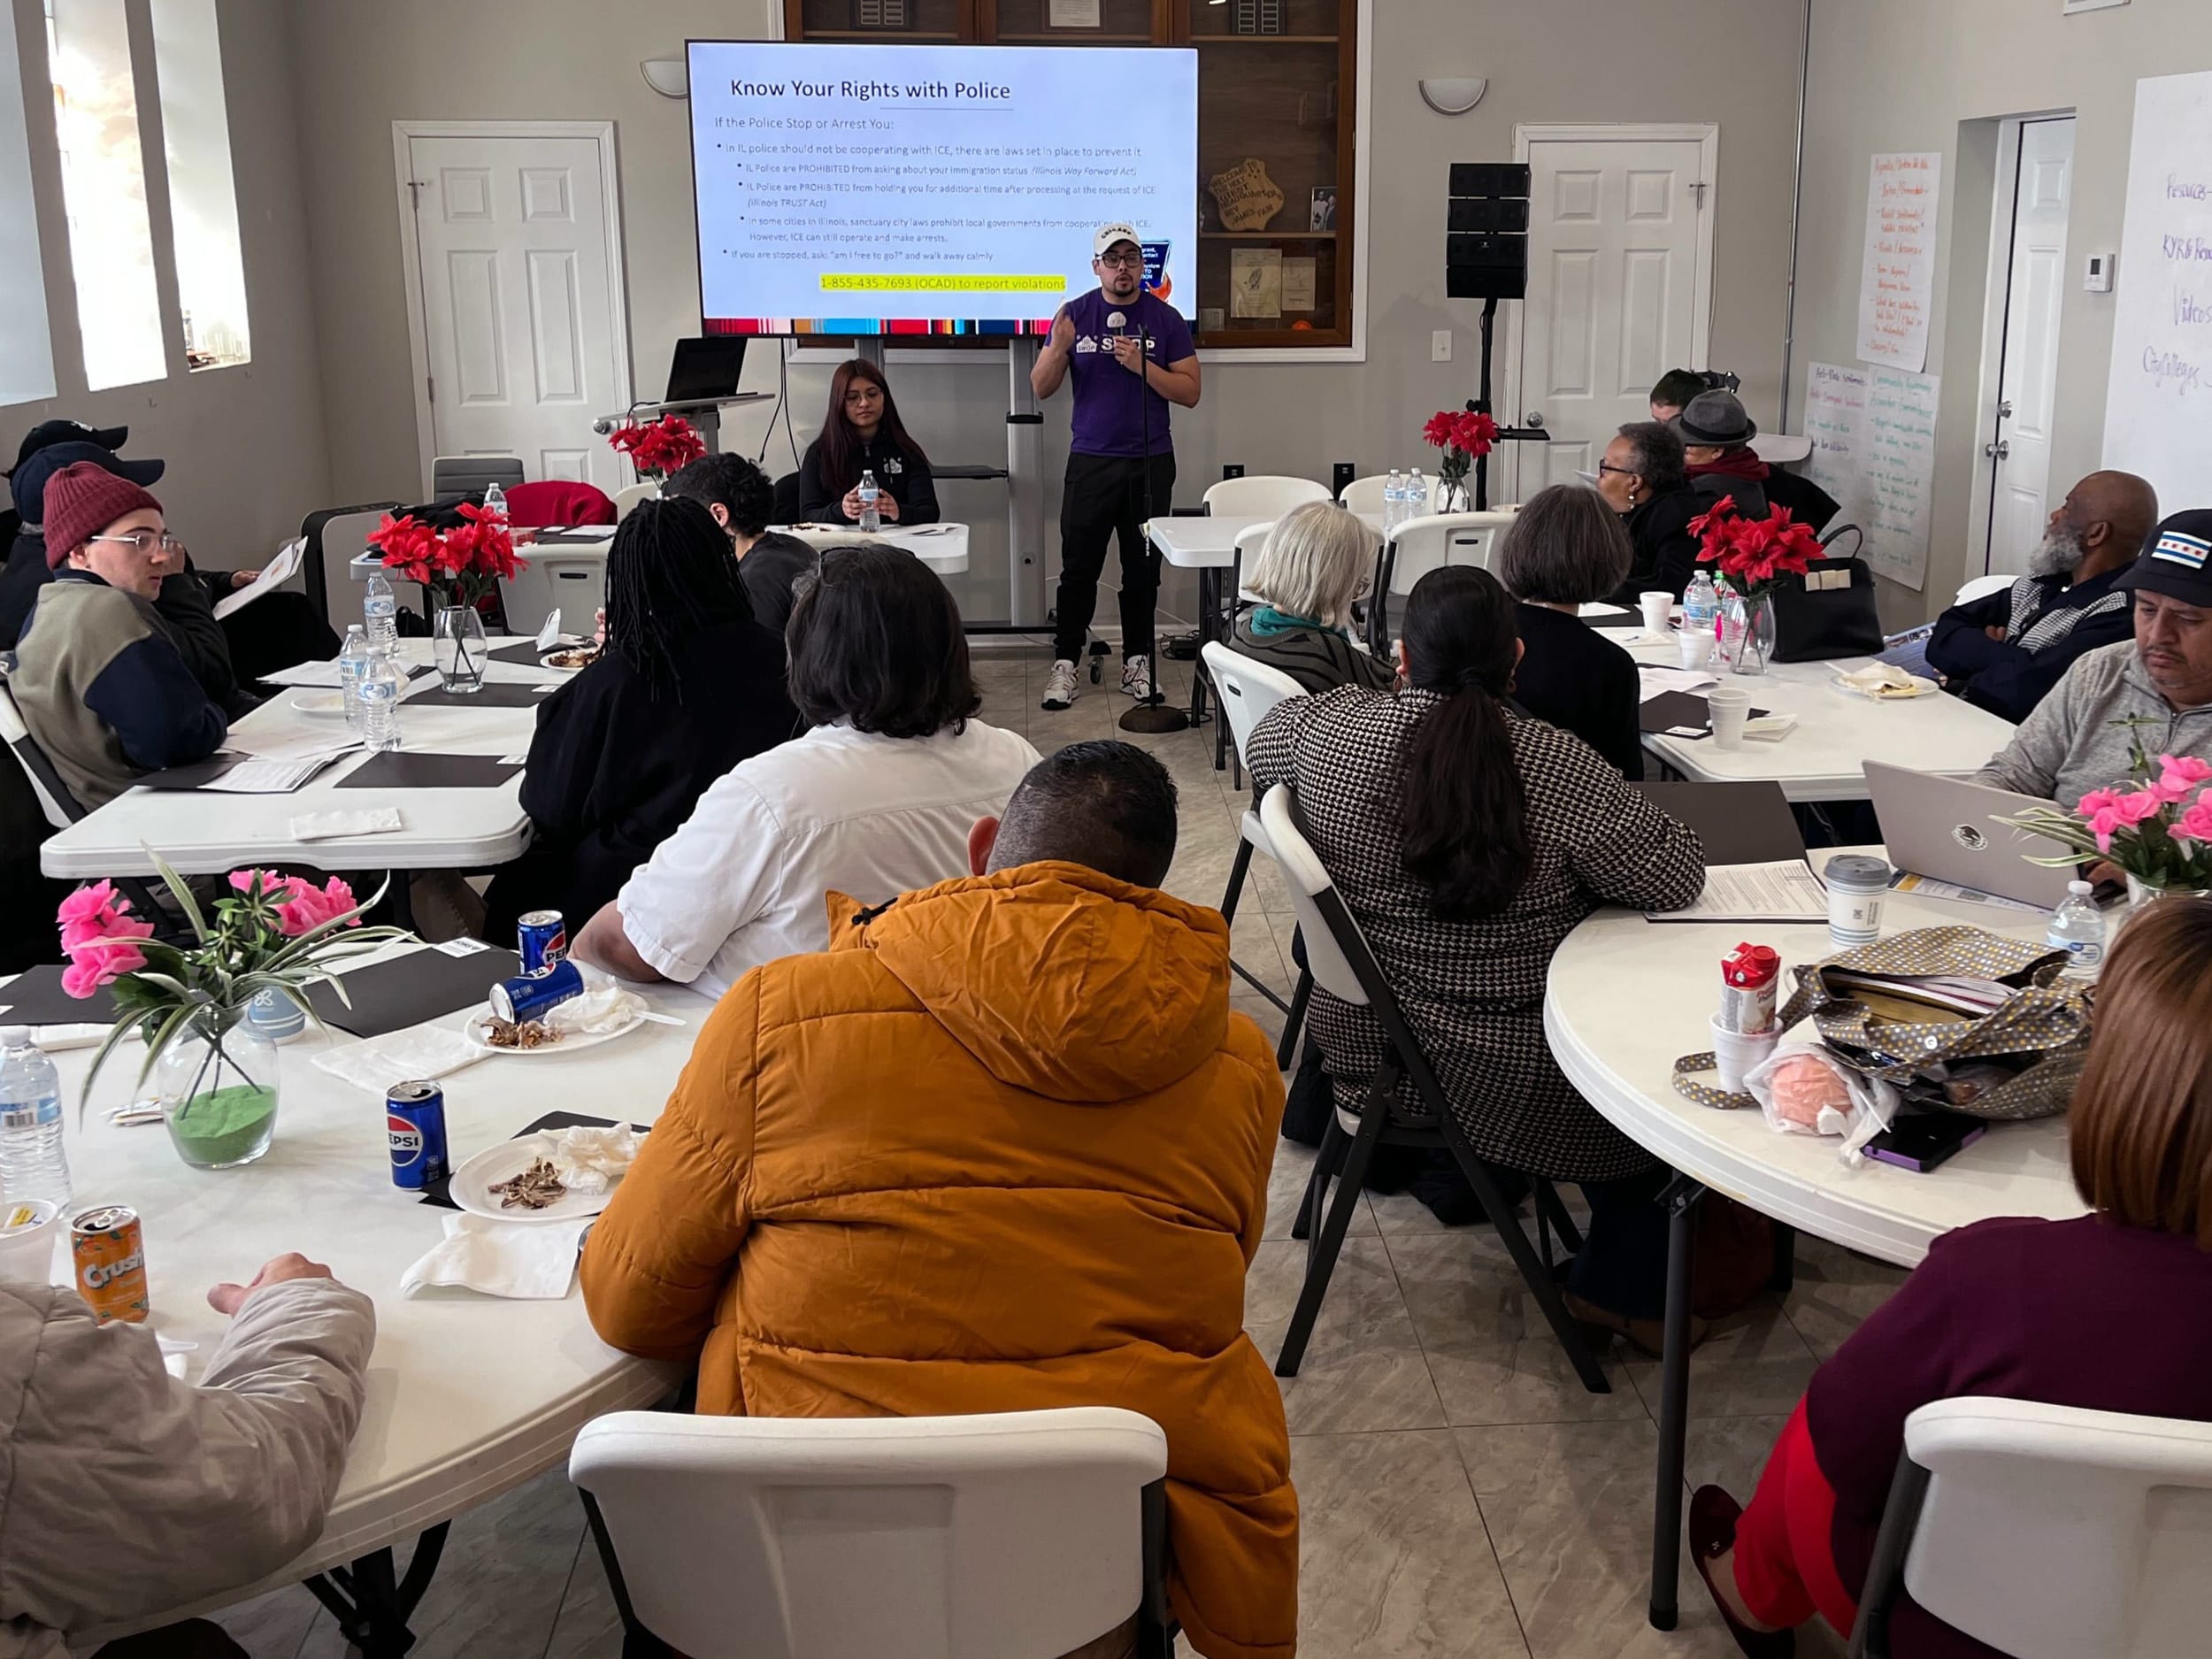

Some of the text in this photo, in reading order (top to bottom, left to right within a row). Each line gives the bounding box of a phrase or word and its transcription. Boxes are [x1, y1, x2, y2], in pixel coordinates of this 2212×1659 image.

[731, 80, 1010, 101] Know Your Rights with Police
[715, 117, 895, 131] If the Police Stop or Arrest You:
[749, 144, 778, 156] police
[780, 144, 813, 154] should
[835, 145, 847, 154] be
[849, 145, 909, 157] cooperating
[910, 145, 932, 155] with
[934, 146, 953, 157] ICE,
[956, 146, 982, 156] there
[1002, 146, 1024, 156] laws
[1026, 147, 1041, 156] set
[1043, 147, 1052, 156] in
[1055, 147, 1079, 158] place
[1083, 148, 1093, 157] to
[1094, 148, 1131, 158] prevent
[798, 165, 850, 173] PROHIBITED
[852, 165, 872, 173] from
[874, 165, 901, 175] asking
[929, 167, 949, 176] your
[1064, 167, 1082, 177] Way
[1120, 167, 1137, 177] Act)
[799, 183, 850, 192] PROHIBITED
[875, 184, 906, 195] holding
[908, 186, 923, 195] you
[926, 184, 937, 193] for
[983, 185, 1002, 194] time
[1004, 185, 1024, 194] after
[1026, 186, 1071, 196] processing
[1099, 186, 1130, 196] request
[1133, 185, 1141, 194] of
[1143, 186, 1156, 195] ICE
[810, 199, 826, 209] Act)
[850, 219, 891, 228] sanctuary
[893, 219, 908, 228] city
[931, 219, 964, 229] prohibit
[965, 219, 986, 227] local
[987, 219, 1041, 229] governments
[749, 234, 788, 242] However,
[840, 234, 872, 243] operate
[893, 234, 914, 242] make
[774, 251, 810, 261] stopped,
[966, 252, 993, 262] calmly
[821, 278, 1065, 291] 1-855-435-7693 (OCAD) to report violations
[1102, 338, 1156, 351] SP
